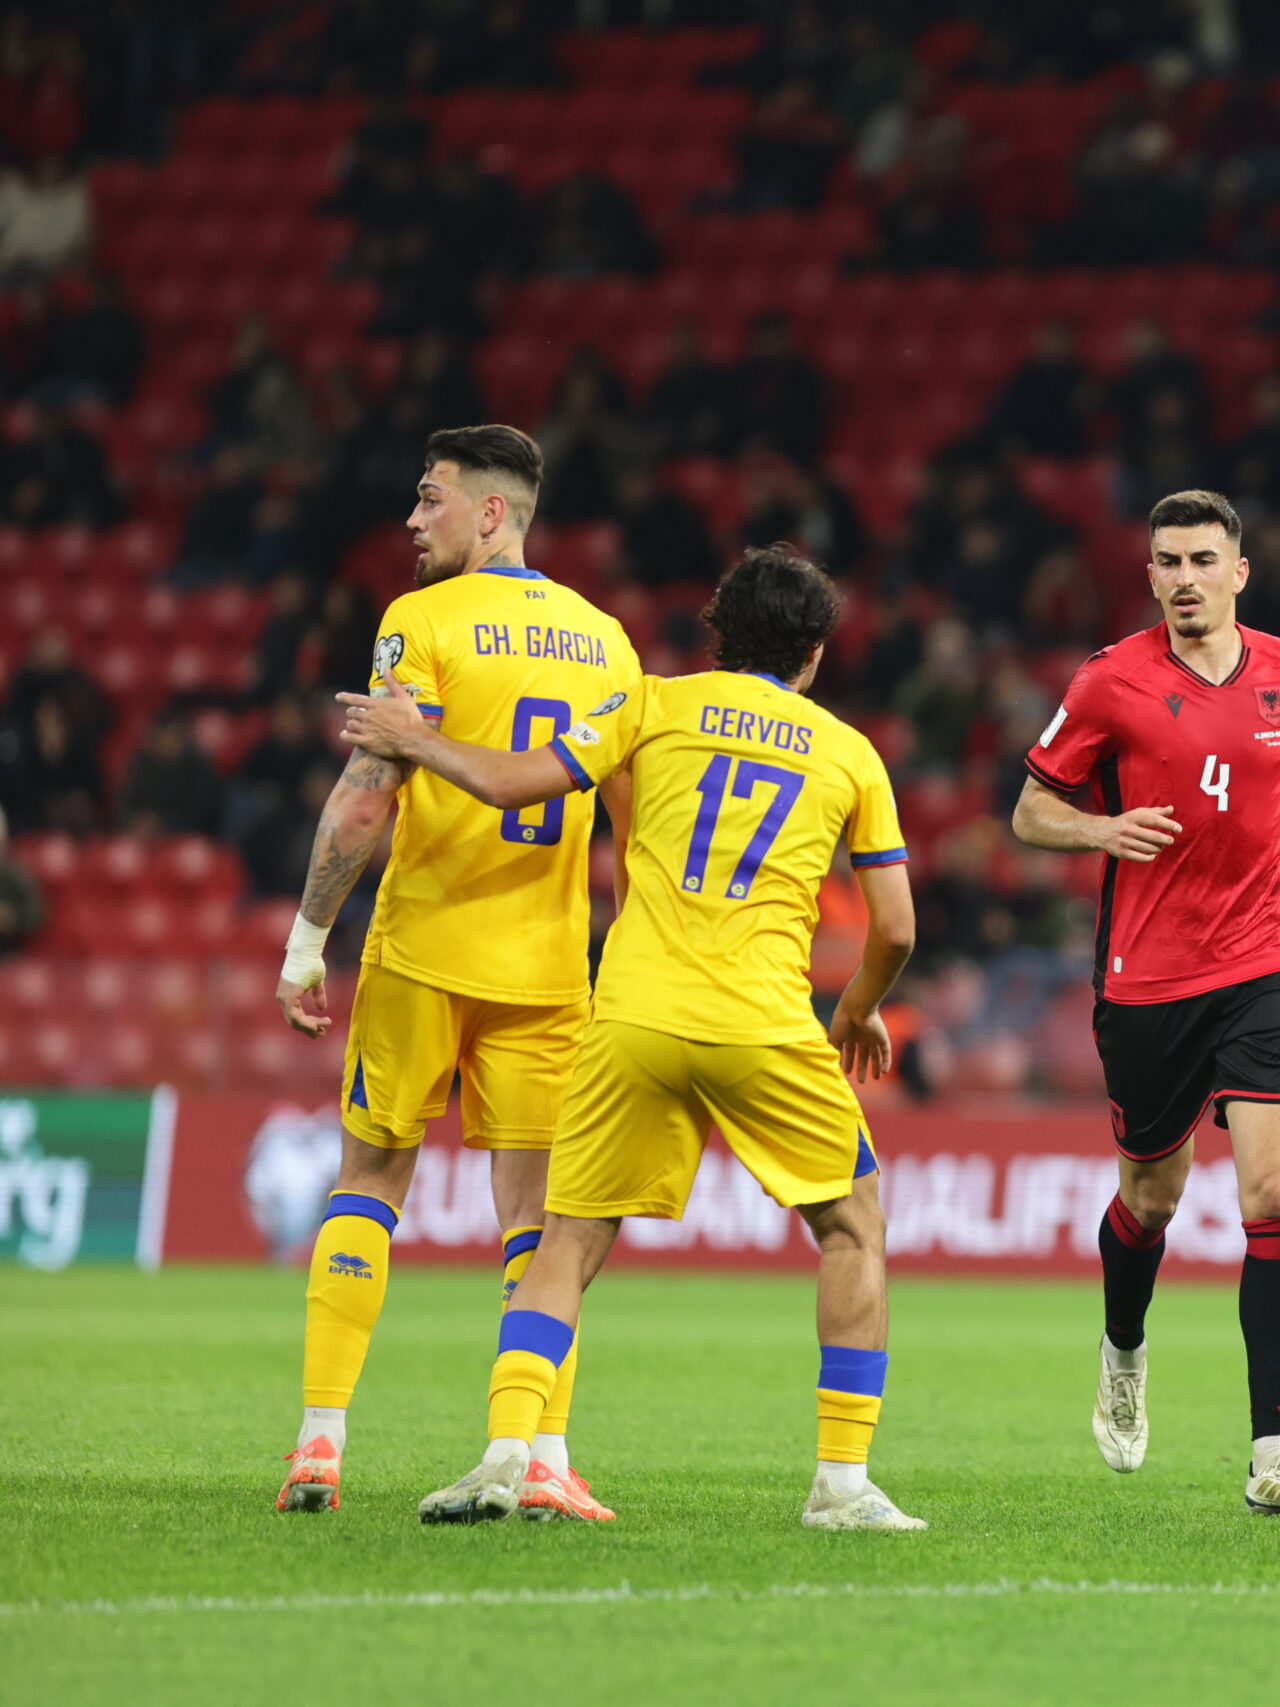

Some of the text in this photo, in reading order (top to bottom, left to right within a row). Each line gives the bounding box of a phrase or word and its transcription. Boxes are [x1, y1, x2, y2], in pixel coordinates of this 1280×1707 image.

[474, 623, 608, 670] CH. GARCIA
[699, 704, 813, 756] CERVOS
[1199, 754, 1231, 812] 4
[681, 753, 806, 901] 17
